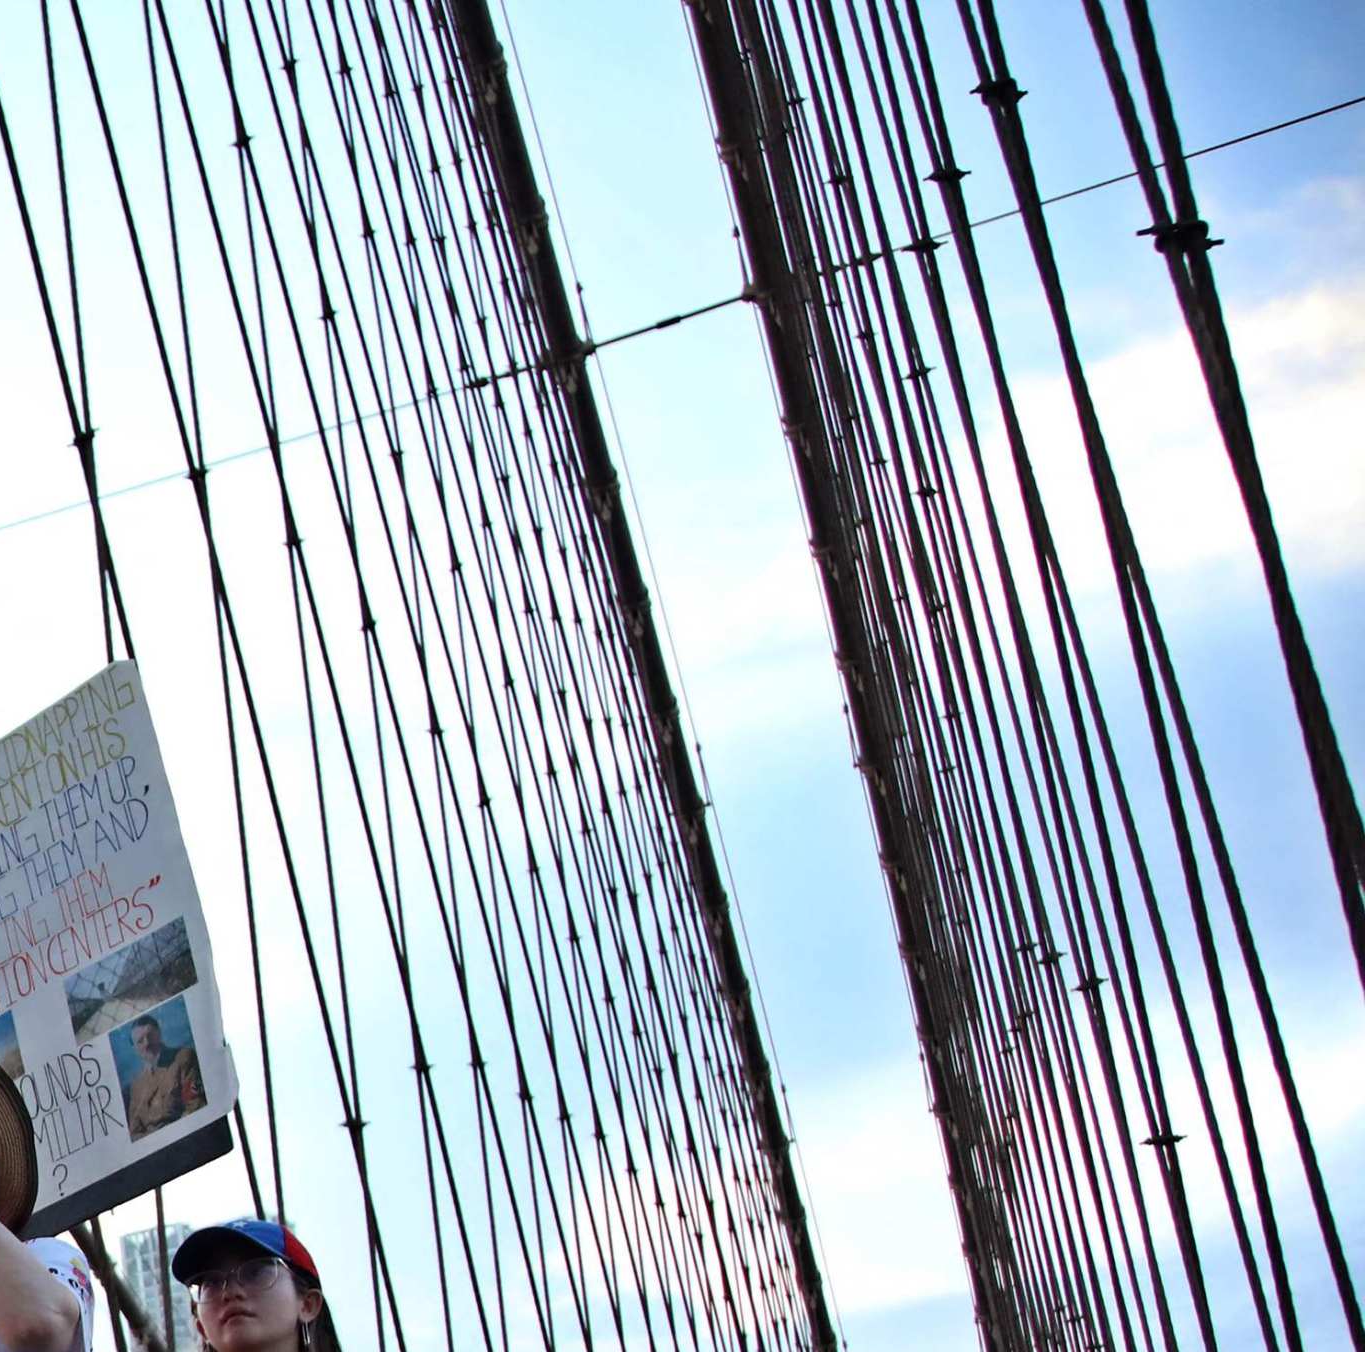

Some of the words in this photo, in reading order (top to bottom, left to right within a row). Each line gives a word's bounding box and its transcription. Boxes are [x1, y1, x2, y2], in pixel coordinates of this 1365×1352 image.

[77, 718, 126, 776] HIS
[39, 774, 105, 842] THEM
[16, 832, 96, 902] THEM
[95, 798, 149, 864] AND
[52, 862, 114, 929] THEM
[20, 1043, 101, 1120] OUNDS
[53, 1163, 68, 1197] ?
